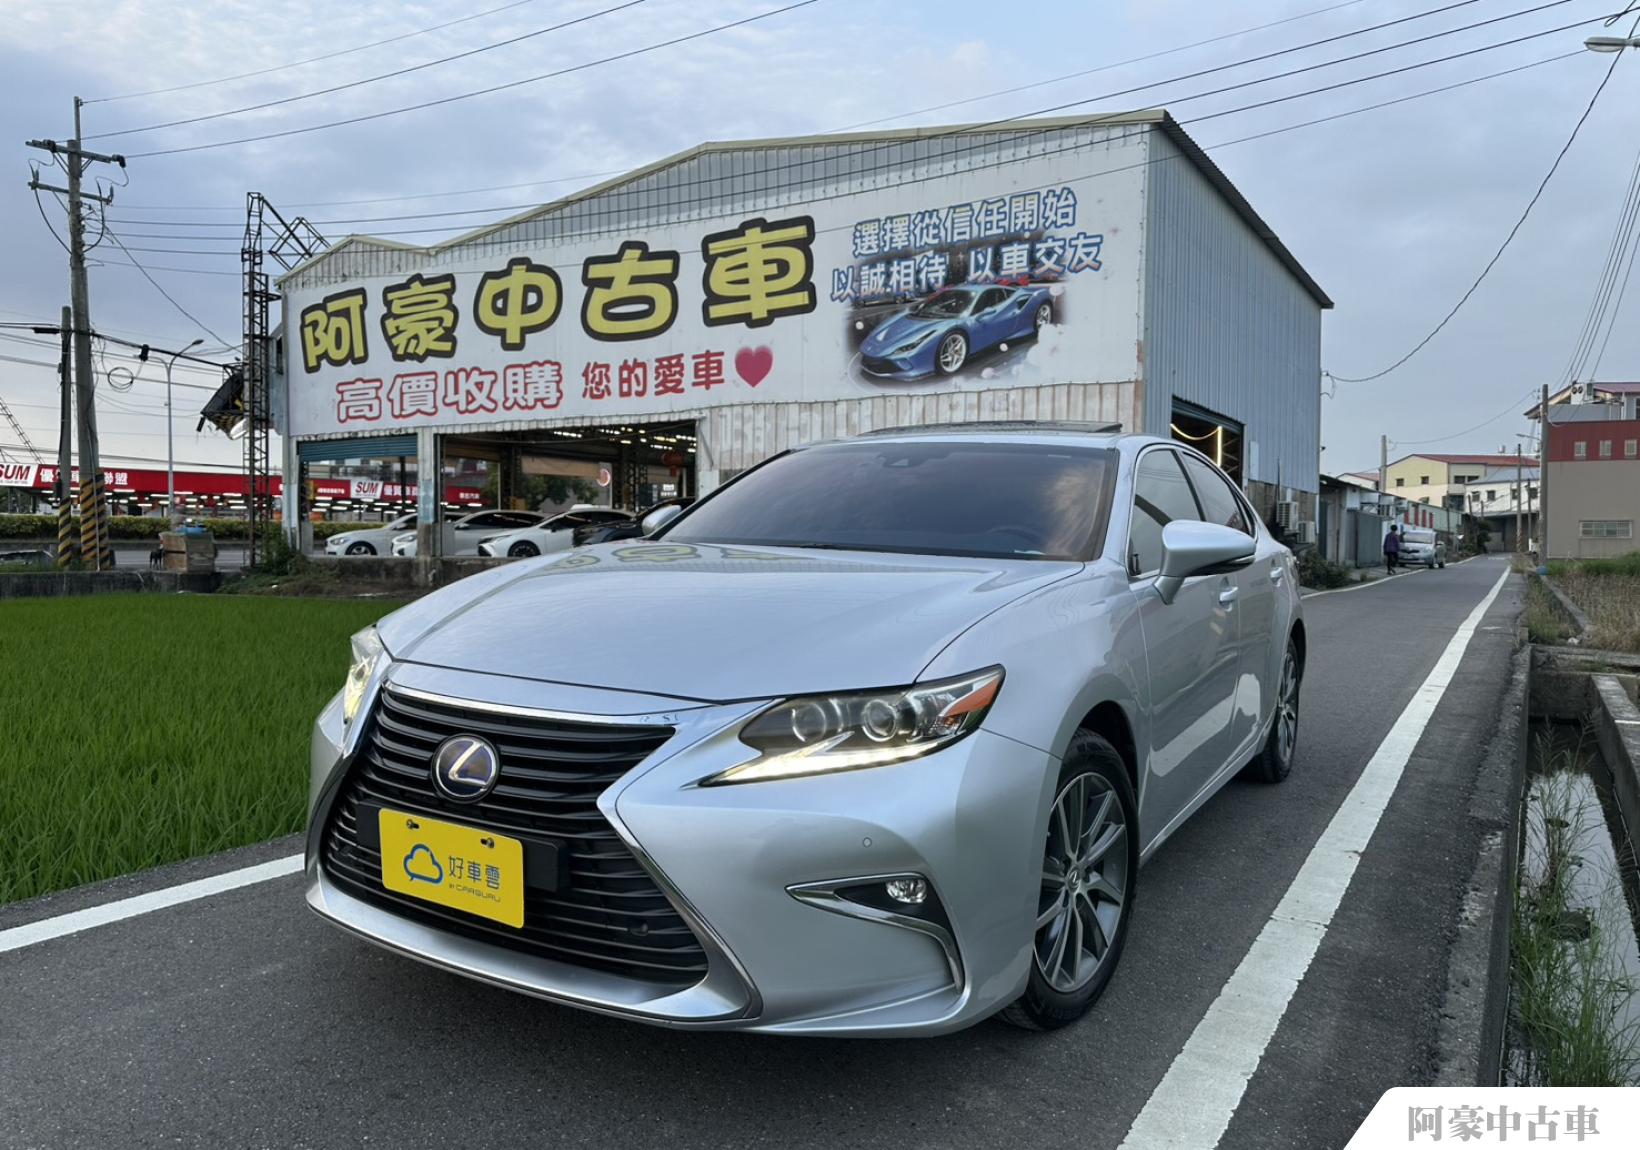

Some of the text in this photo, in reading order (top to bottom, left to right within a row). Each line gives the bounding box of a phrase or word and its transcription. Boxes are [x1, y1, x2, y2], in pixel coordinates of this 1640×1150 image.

[853, 187, 1078, 257] 選擇從信任開始
[301, 216, 816, 373] 阿豪中古車
[831, 232, 1104, 303] 以誠相待 以車交友
[336, 349, 725, 423] 高價收購 您的愛車
[355, 481, 379, 493] SUM
[448, 855, 500, 890] 好車雲
